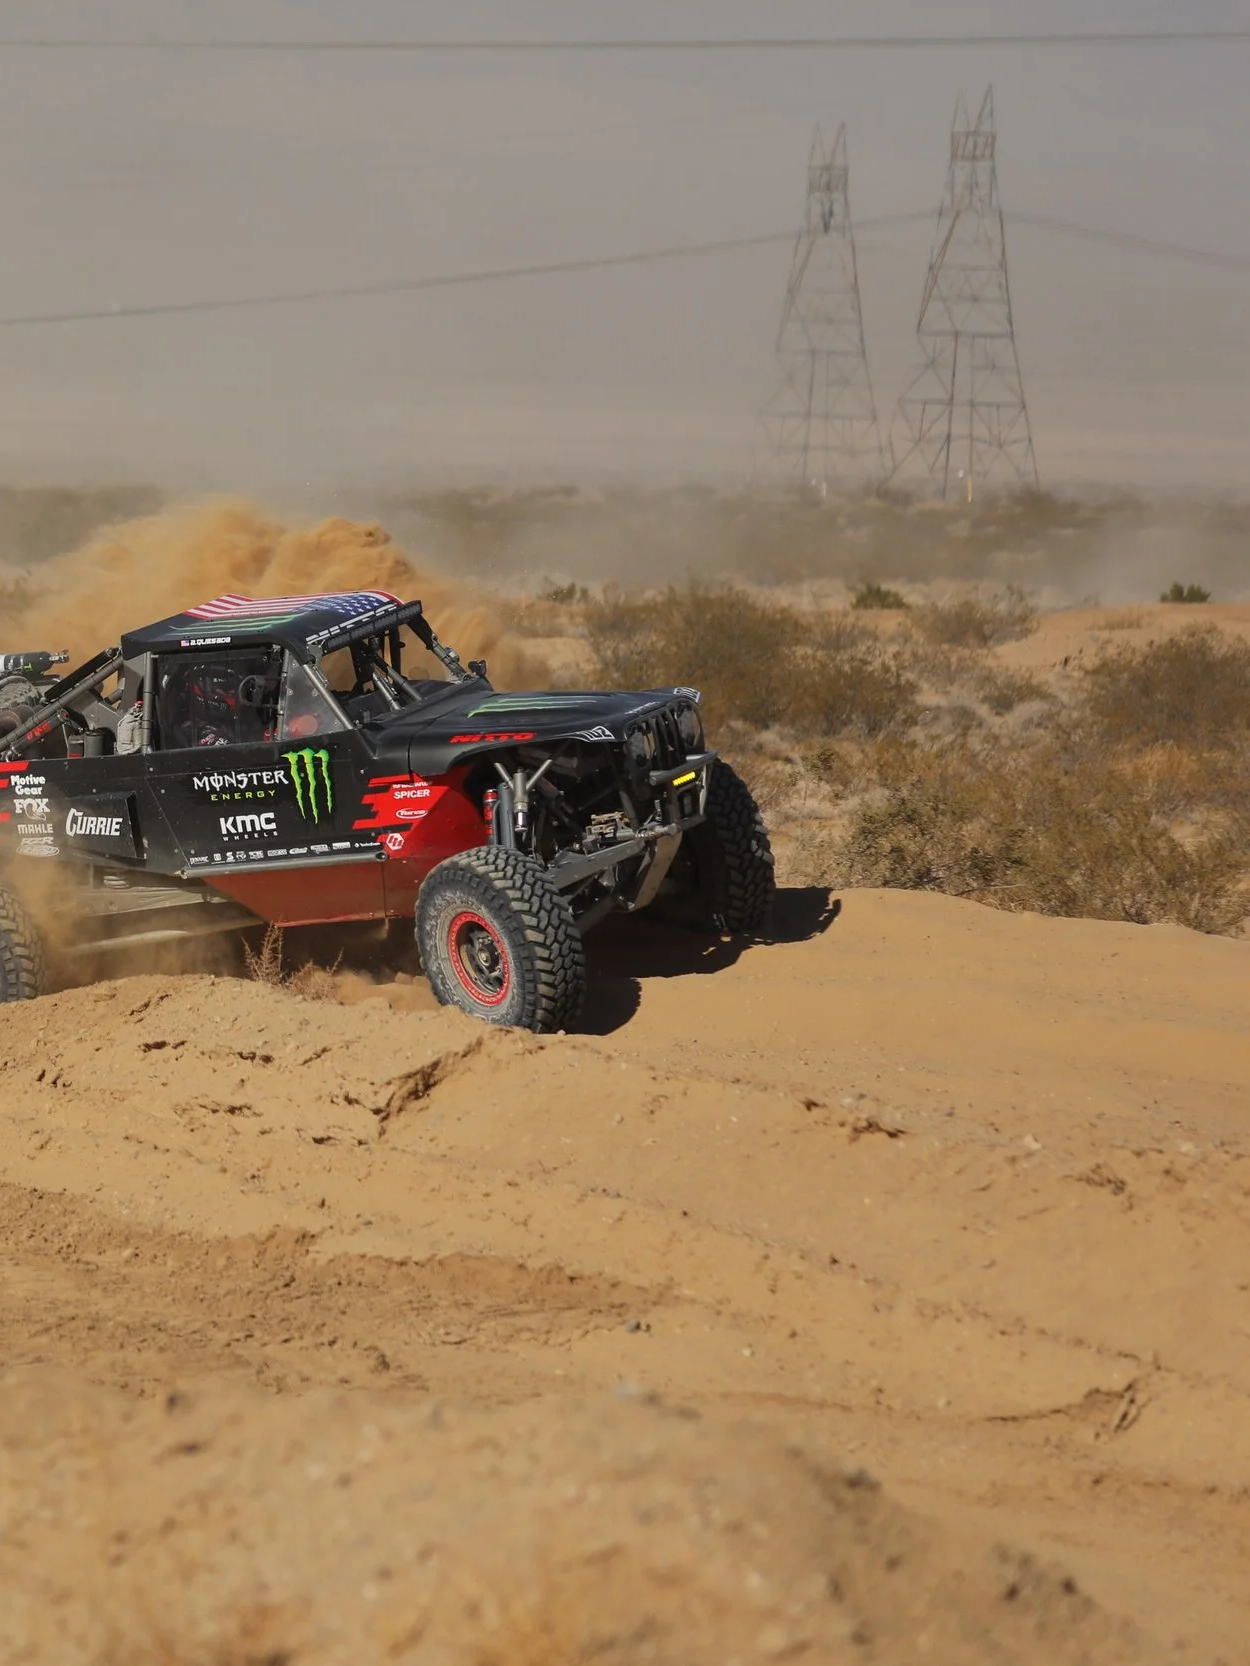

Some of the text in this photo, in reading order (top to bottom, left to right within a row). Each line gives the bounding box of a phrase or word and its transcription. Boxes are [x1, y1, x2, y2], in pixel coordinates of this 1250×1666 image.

[449, 732, 538, 744] NITTO
[10, 774, 46, 786] Motive
[192, 769, 290, 793] MONSTER
[15, 785, 43, 796] Gear
[210, 789, 277, 802] ENERGY
[393, 789, 431, 800] SPICER
[13, 798, 51, 818] FOX
[65, 807, 123, 837] CURRIE
[219, 812, 277, 835] KMC
[17, 823, 54, 835] MAHLE
[222, 831, 279, 842] WHEELS
